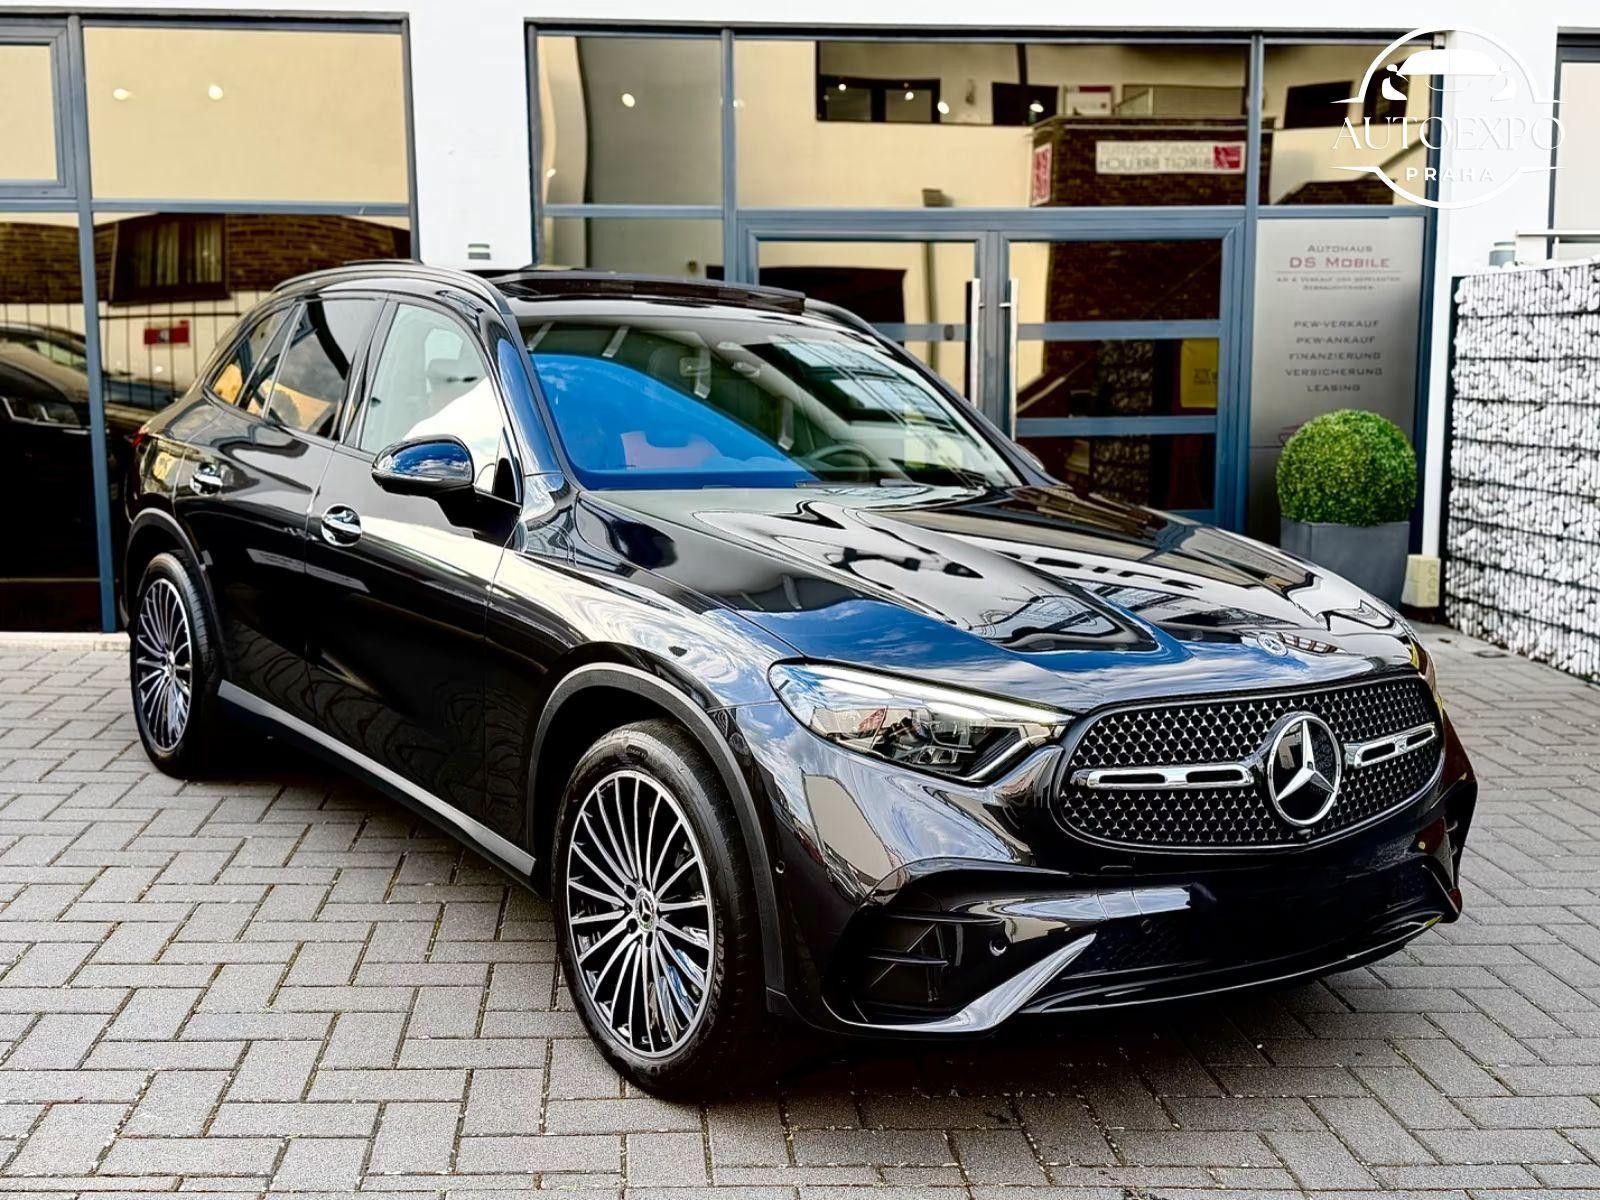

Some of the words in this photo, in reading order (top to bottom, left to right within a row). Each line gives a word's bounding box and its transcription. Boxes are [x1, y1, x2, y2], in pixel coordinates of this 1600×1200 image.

[1307, 245, 1372, 253] AUTOHAUS
[1289, 257, 1316, 268] DS
[1325, 257, 1390, 268] MOBILE
[1289, 352, 1381, 360] FINANZIERUNG
[1285, 368, 1383, 376] VERSICHERUNG
[1307, 384, 1360, 392] LEASING
